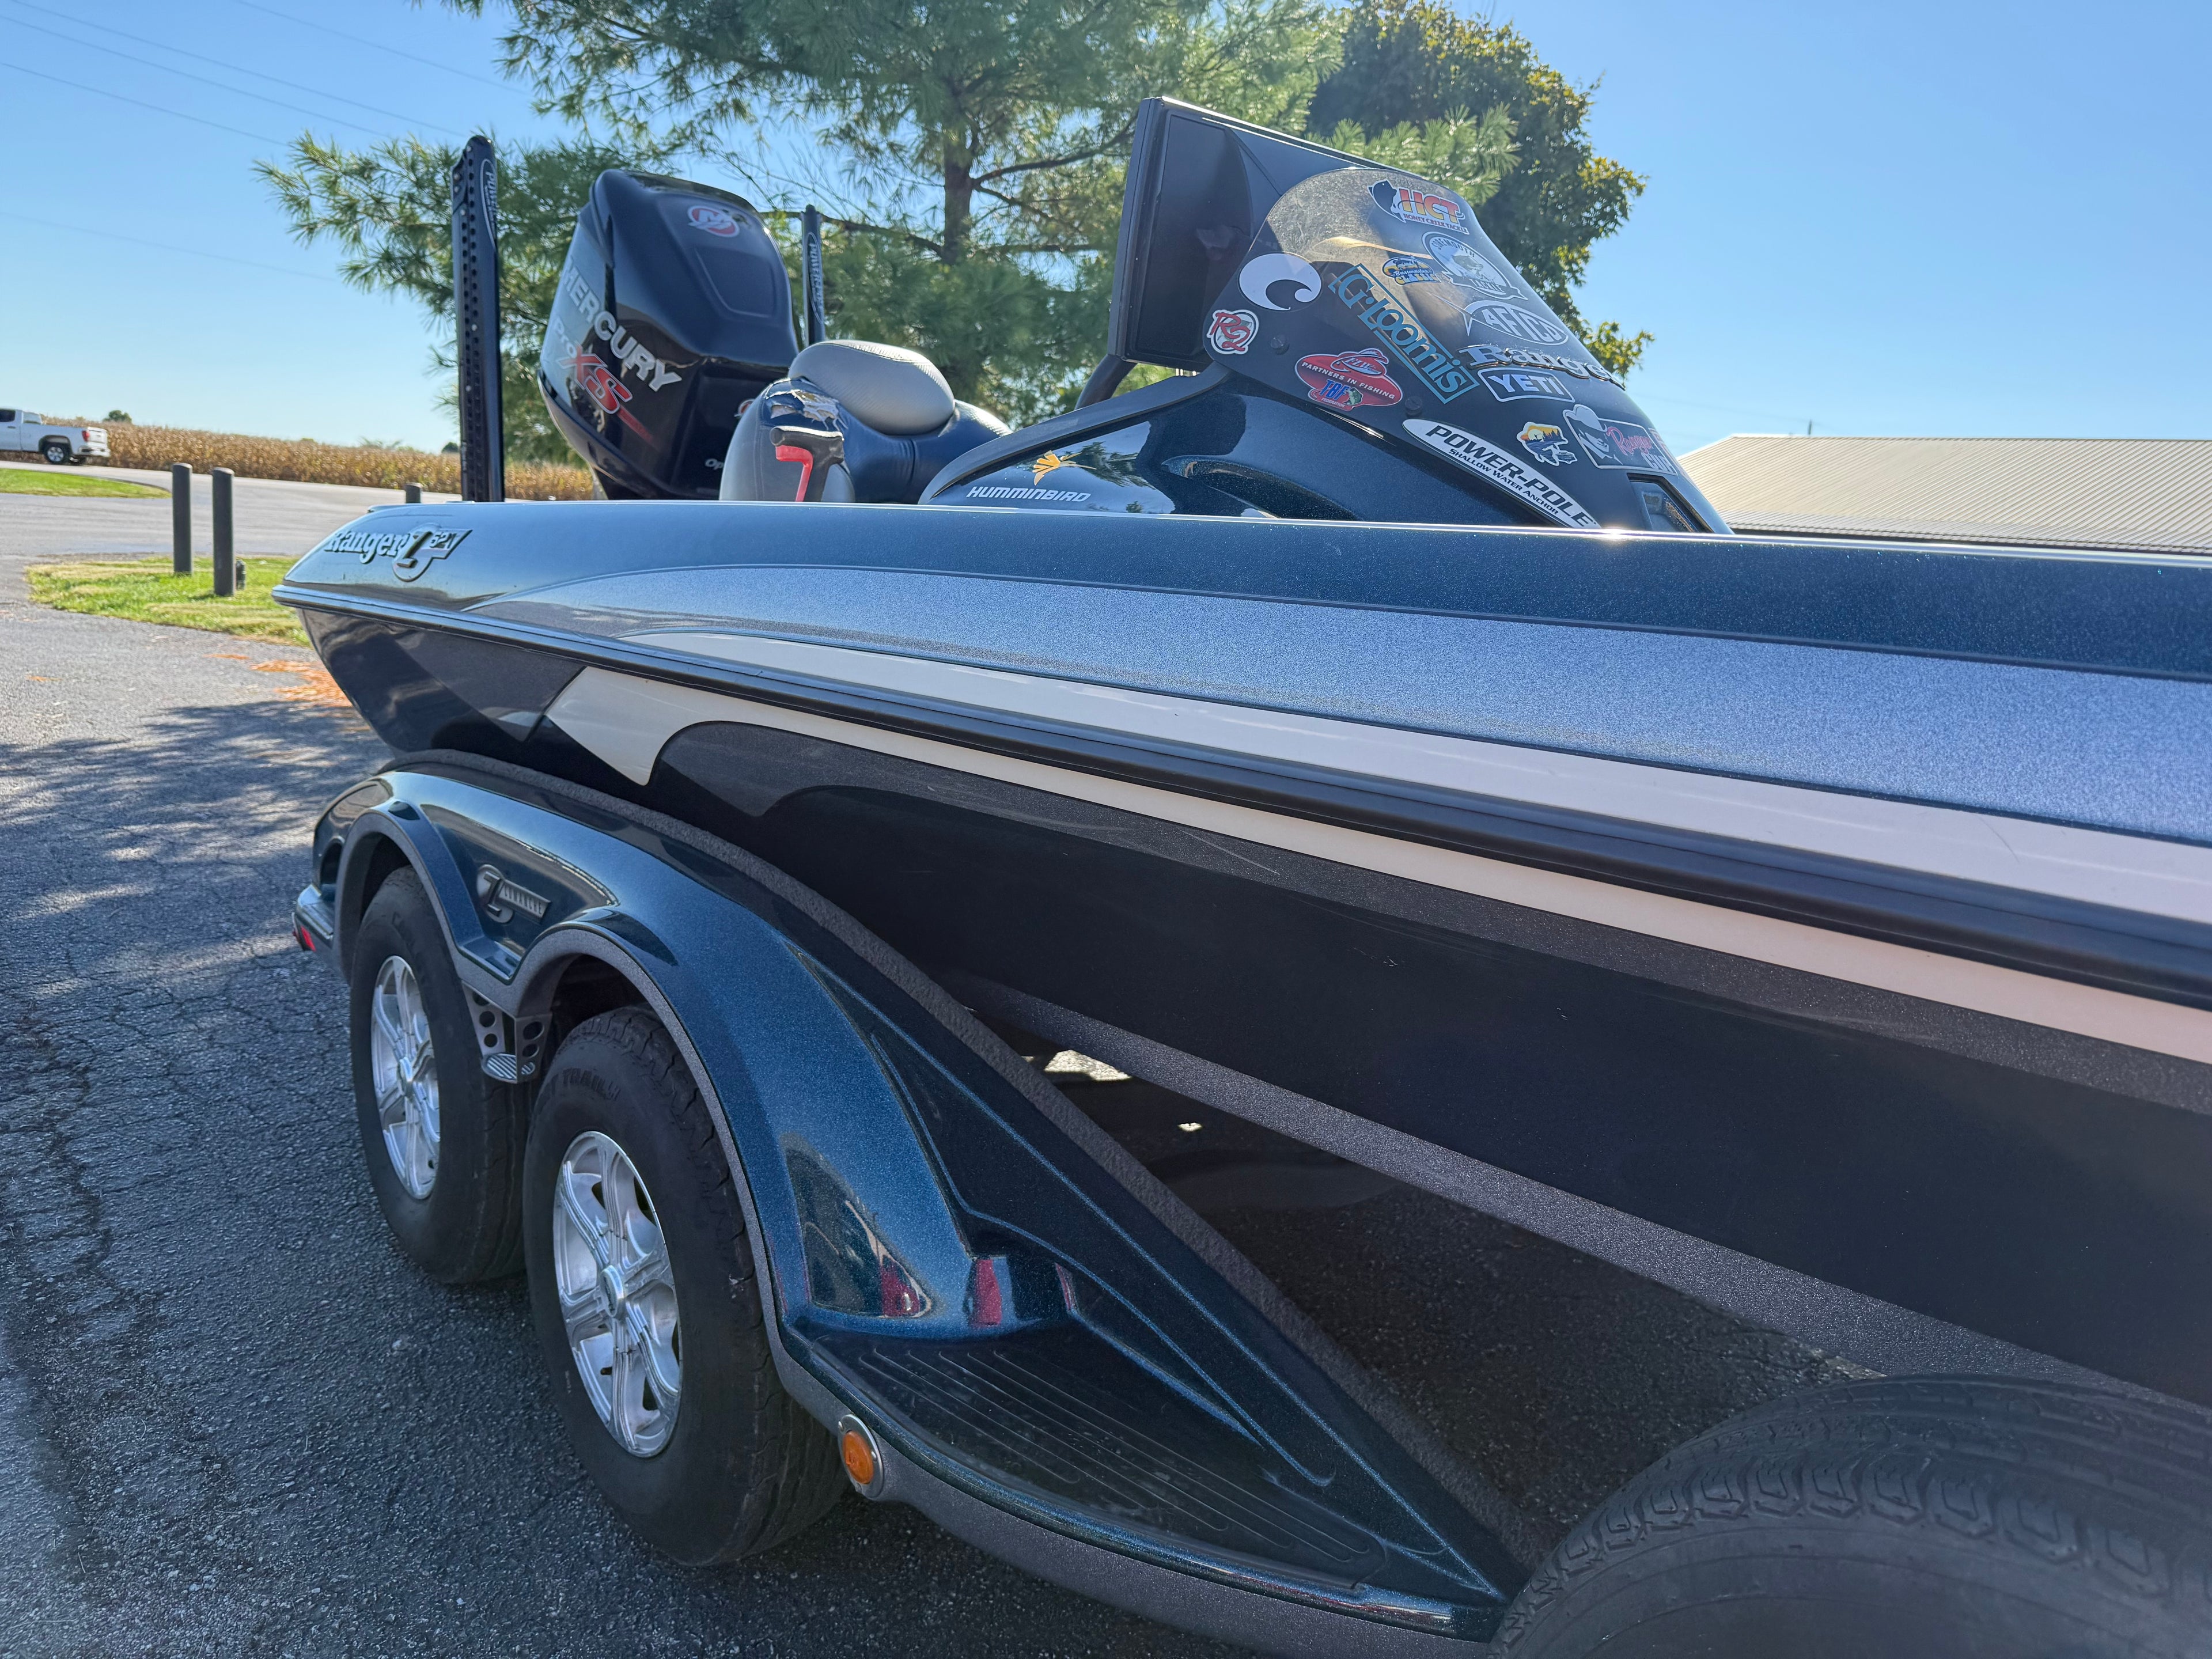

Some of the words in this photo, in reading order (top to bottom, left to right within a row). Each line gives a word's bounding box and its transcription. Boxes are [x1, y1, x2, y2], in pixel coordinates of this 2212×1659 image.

[1399, 188, 1460, 224] HCT
[1403, 213, 1425, 224] HONEY
[1426, 218, 1445, 228] CREEK
[1395, 273, 1439, 285] CLASSIC
[1469, 278, 1506, 293] TACKLE
[562, 255, 683, 392] MERCURY
[1209, 312, 1251, 352] R2
[555, 342, 633, 414] XS
[1301, 361, 1346, 381] PARTNERS
[1347, 377, 1357, 385] IN
[1359, 382, 1395, 400] FISHING
[1487, 374, 1565, 396] YETI
[1606, 426, 1654, 457] Ranger
[1425, 425, 1593, 527] POWER-POLE
[1641, 452, 1675, 473] CUP
[965, 486, 1092, 502] HUMMINBIRD
[1448, 448, 1492, 472] SHALLOW
[1492, 469, 1522, 491] WATER
[1522, 489, 1559, 514] ANCHOR
[323, 530, 410, 565] Ranger
